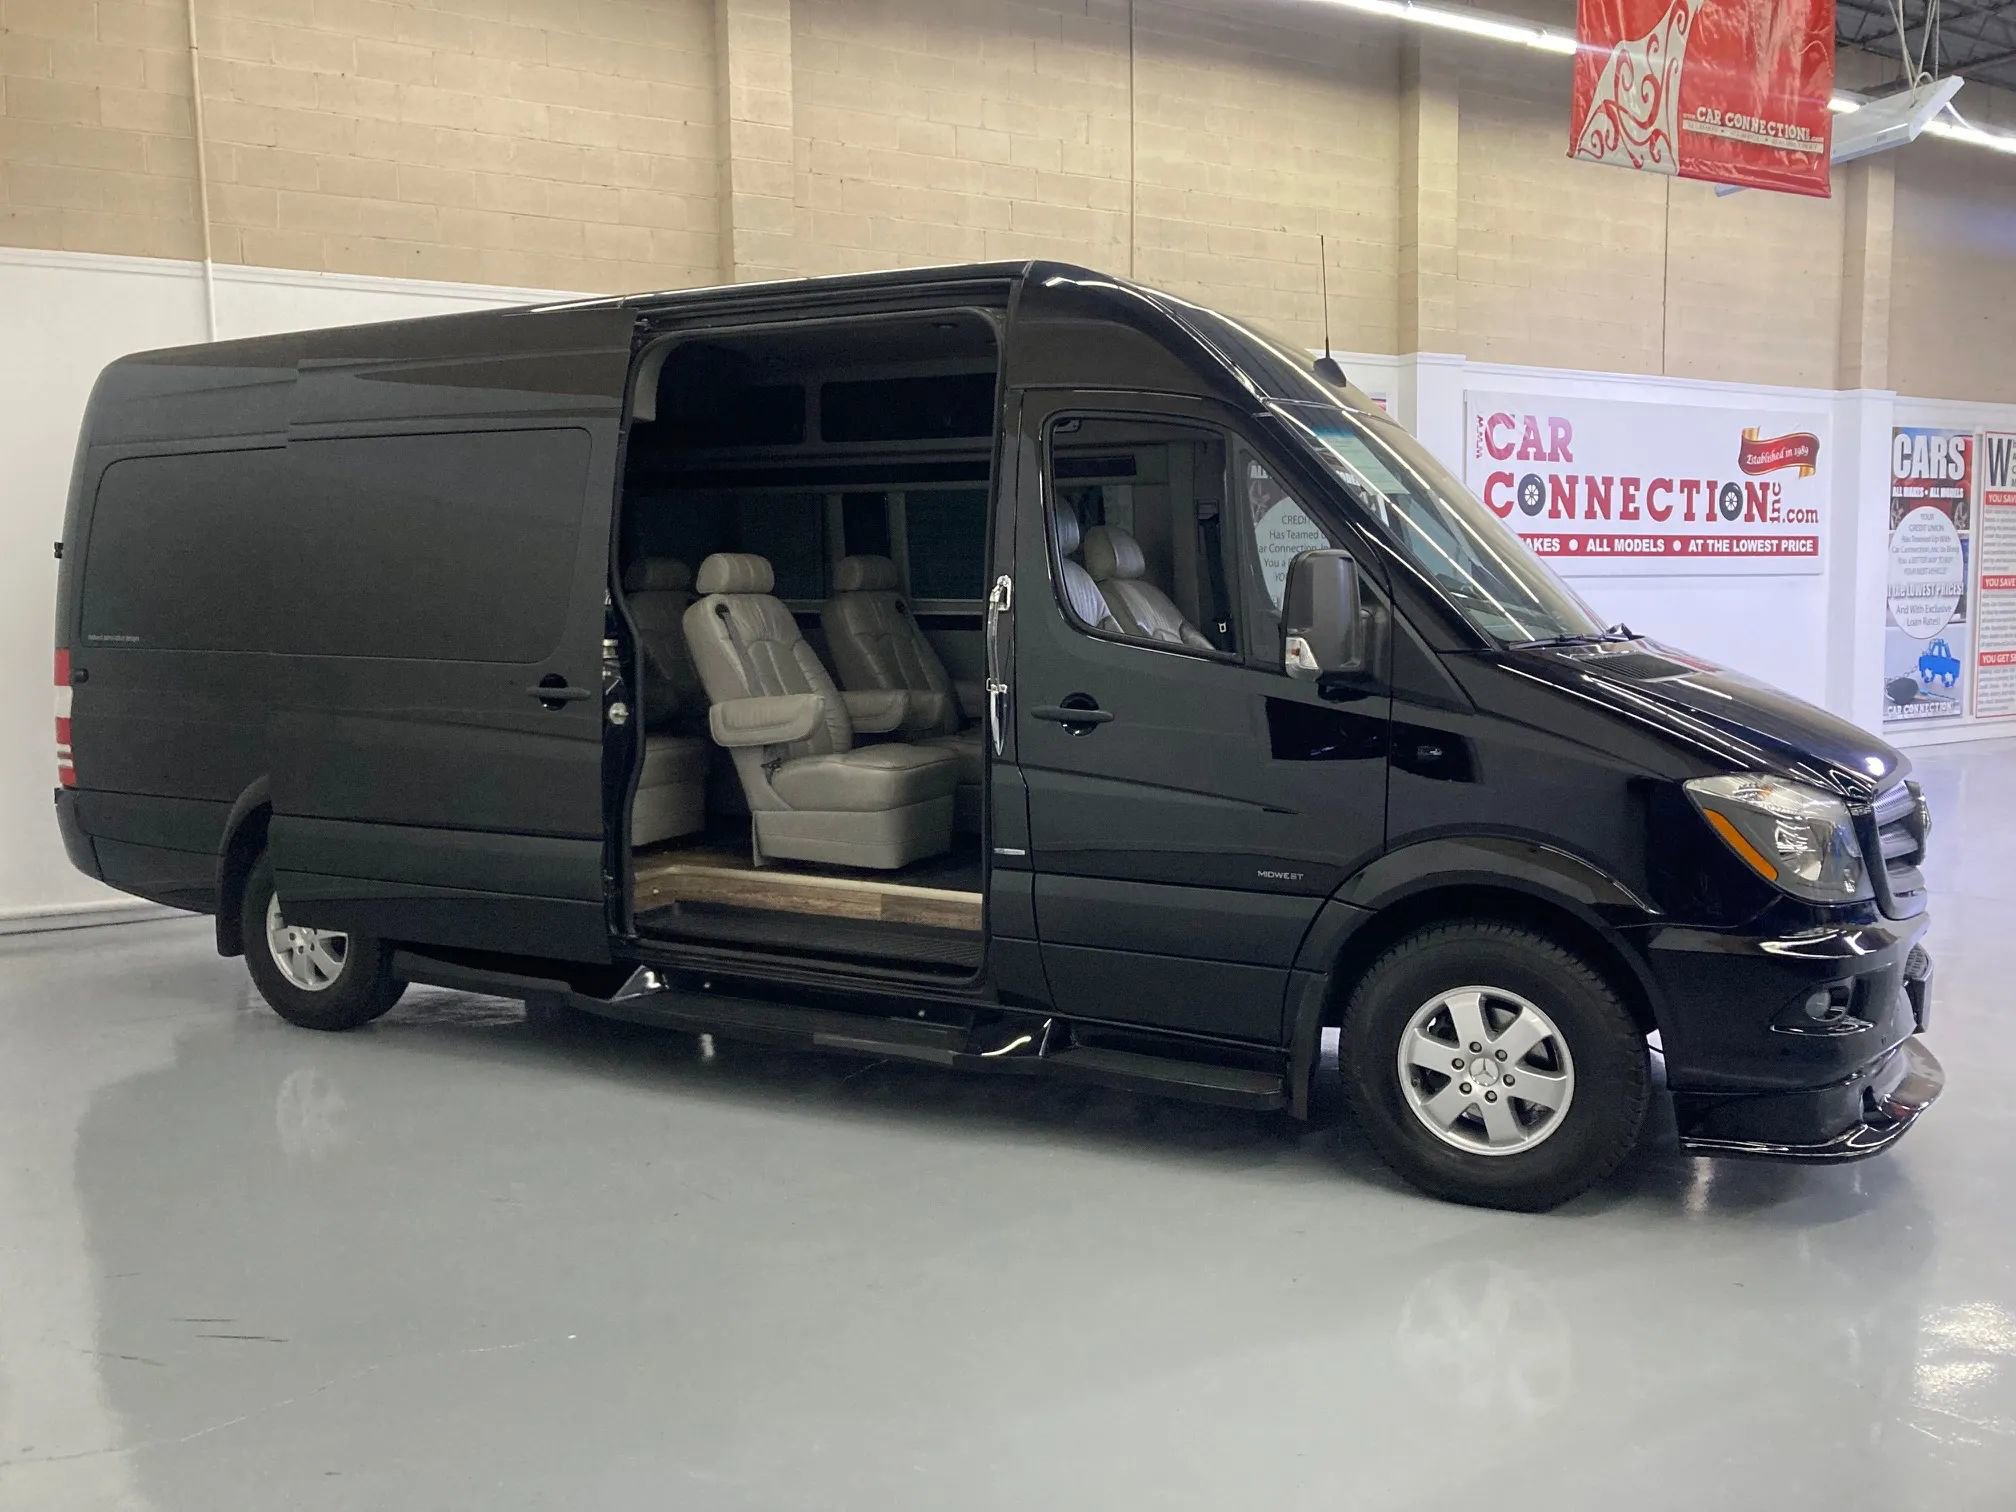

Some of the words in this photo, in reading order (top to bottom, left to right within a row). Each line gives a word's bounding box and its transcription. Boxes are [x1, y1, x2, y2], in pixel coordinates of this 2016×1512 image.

[1696, 106, 1722, 125] CAR
[1725, 112, 1806, 141] CONNECTION
[1485, 412, 1573, 462] CAR
[1794, 445, 1809, 457] 1989
[1893, 434, 1965, 480] CARS
[1484, 471, 1770, 523] CONNECTION
[1782, 508, 1819, 523] .com
[1269, 530, 1285, 539] Has
[1287, 530, 1319, 540] Teamed
[1587, 539, 1611, 551] ALL
[1614, 539, 1665, 552] MODELS
[1688, 540, 1705, 553] AT
[1707, 540, 1730, 552] THE
[1733, 541, 1778, 553] LOWEST
[1781, 541, 1814, 552] PRICE
[1264, 558, 1280, 568] You
[1257, 870, 1304, 880] MIDWEST
